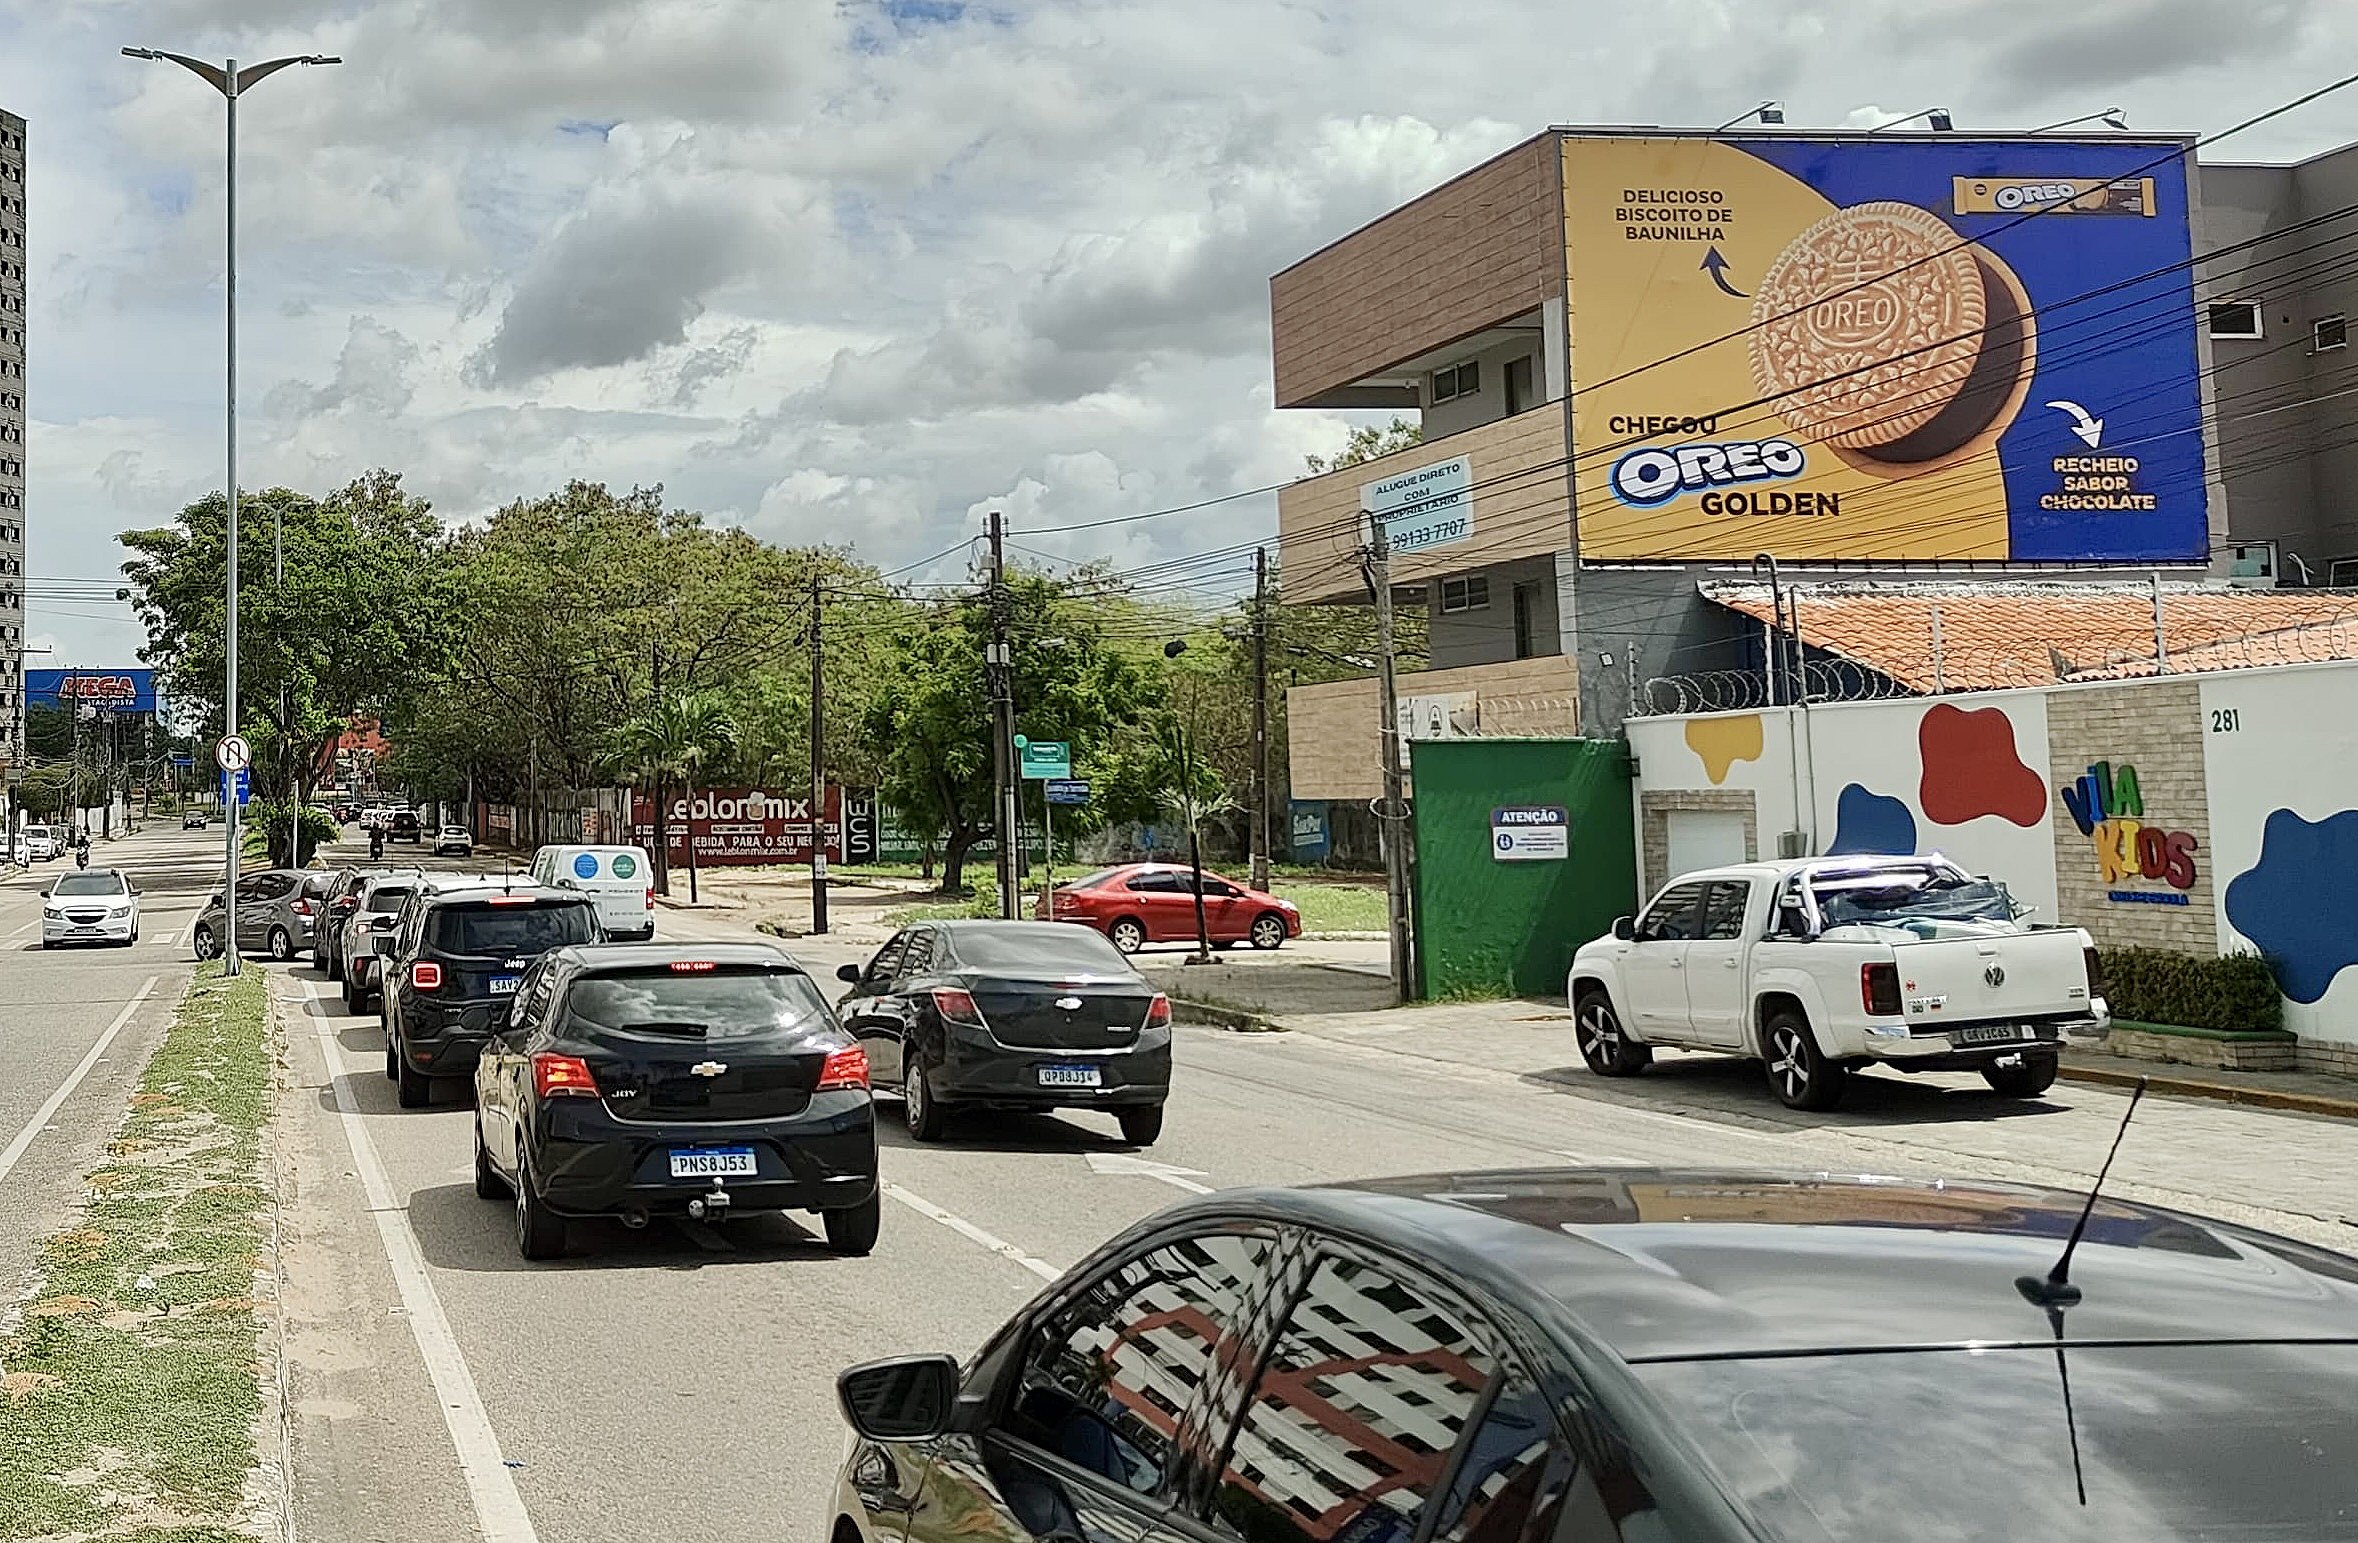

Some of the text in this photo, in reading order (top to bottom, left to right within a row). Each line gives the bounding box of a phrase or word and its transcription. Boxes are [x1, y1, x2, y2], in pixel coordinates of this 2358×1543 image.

[1623, 190, 1723, 204] DELICIOSO
[1996, 183, 2076, 210] OREO
[1616, 208, 1733, 223] BISCOITO DE
[1625, 226, 1725, 241] BAUNILHA
[1816, 298, 1892, 329] OREO
[1609, 416, 1717, 435] CHEGOU
[1612, 439, 1805, 505] OREO
[2053, 457, 2139, 473] RECHEIO
[1376, 463, 1460, 495] ALUGUE DIRETO
[2063, 476, 2130, 492] SABOR
[1404, 487, 1430, 501] COM
[2040, 494, 2156, 510] CHOCOLATE
[1701, 492, 1840, 517] GOLDEN
[1392, 518, 1466, 549] 99133 7707
[2211, 709, 2240, 733] 281
[763, 797, 810, 820] mix
[1501, 808, 1558, 824] ATENÇÃO
[691, 836, 725, 848] EBIDA
[732, 836, 760, 847] PARA
[764, 836, 774, 847] O
[776, 836, 795, 847] SEU
[2094, 819, 2198, 889] KIDS
[504, 958, 526, 969] Jeep
[611, 1089, 638, 1098] JOY
[680, 1156, 747, 1173] PNS8J53
